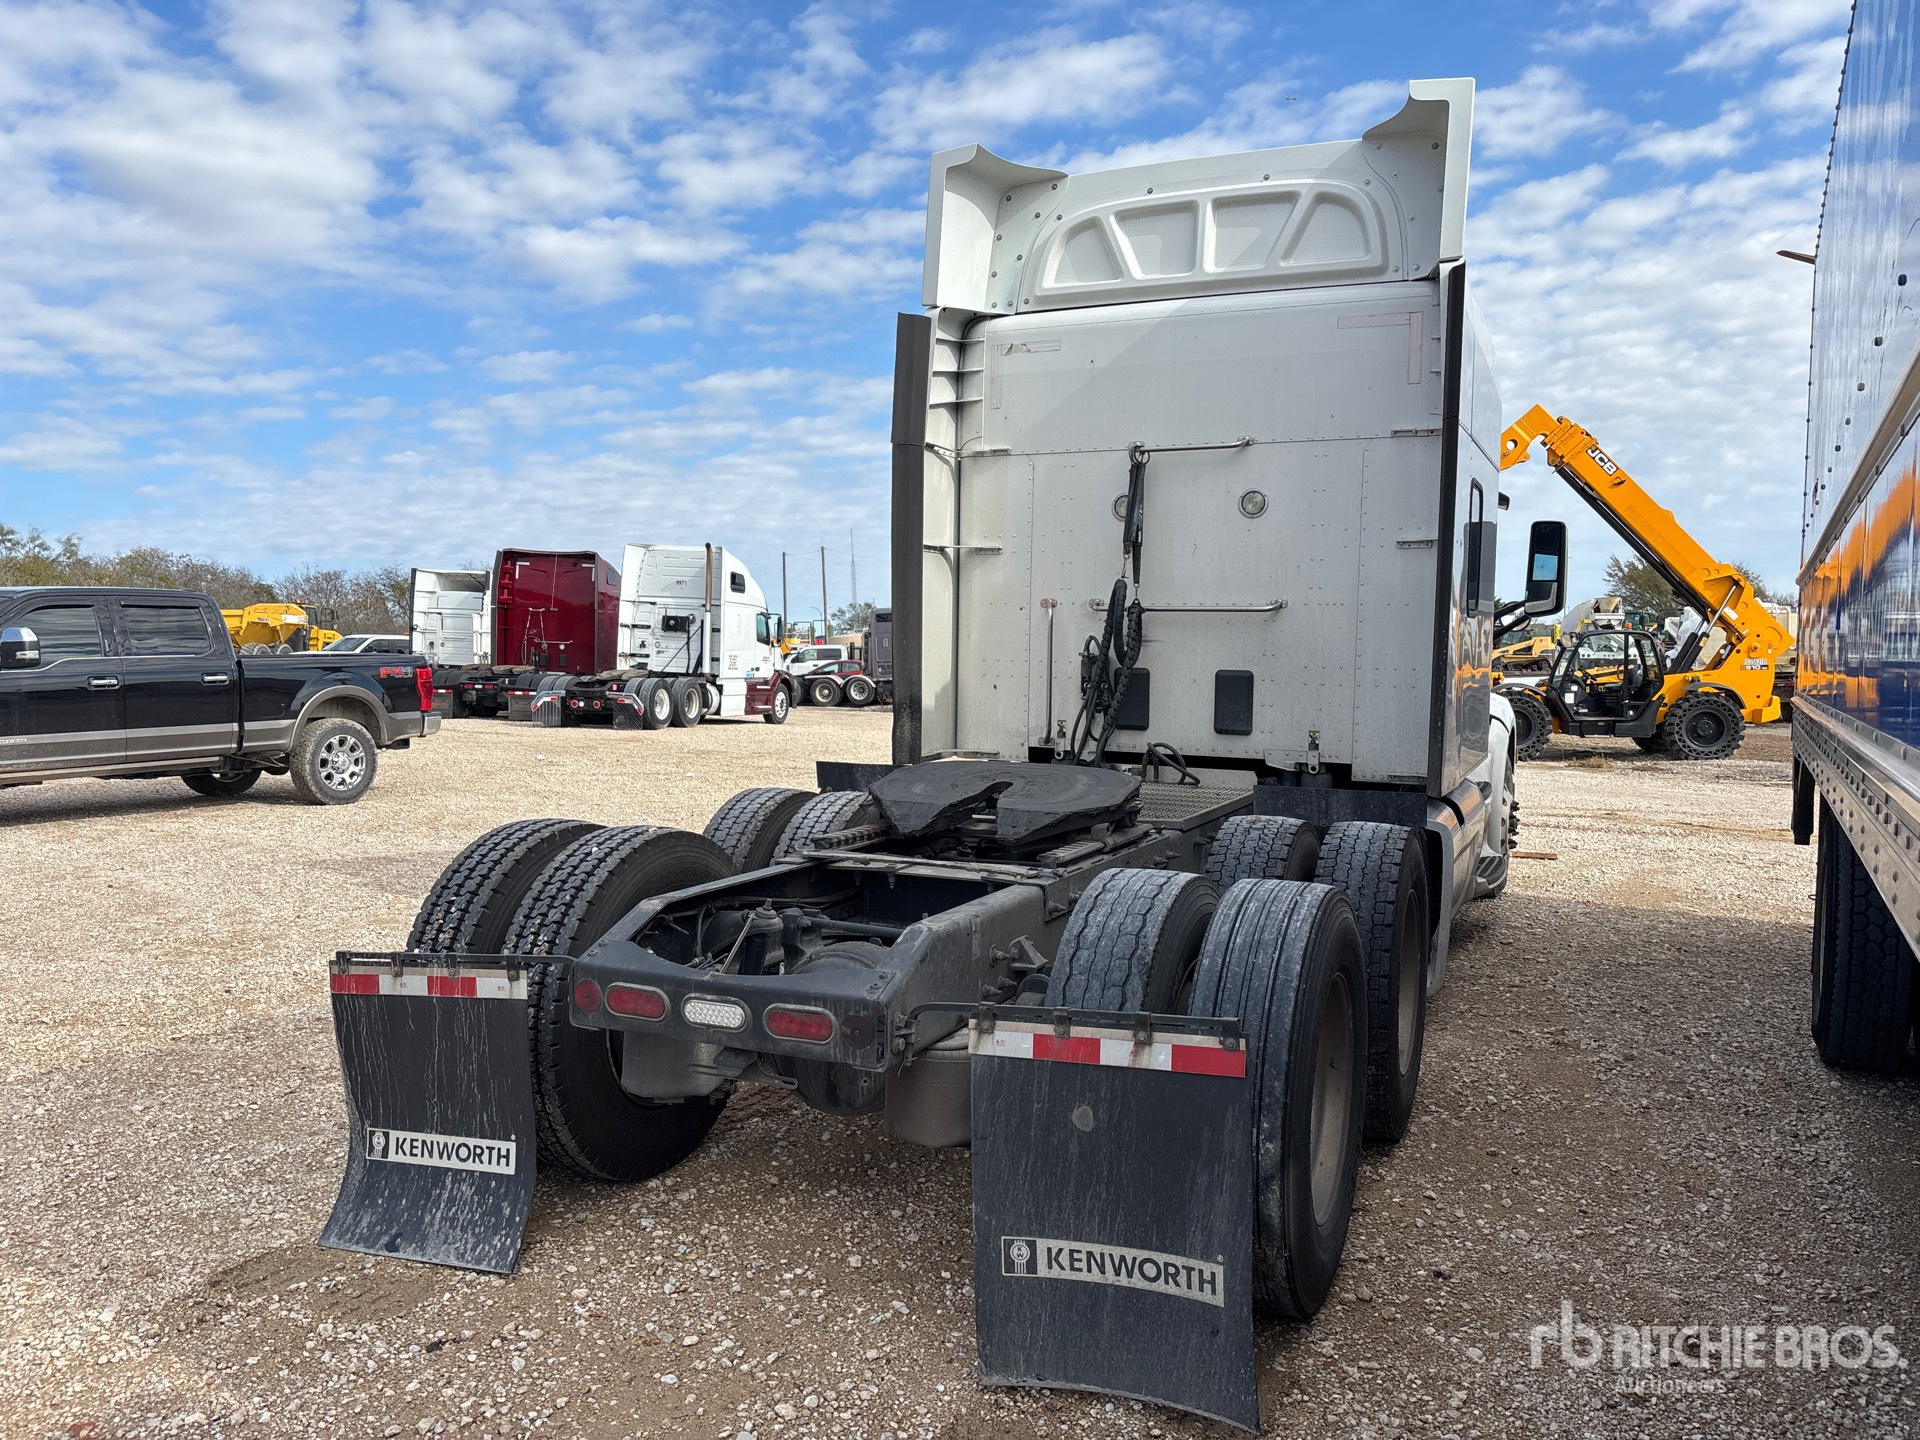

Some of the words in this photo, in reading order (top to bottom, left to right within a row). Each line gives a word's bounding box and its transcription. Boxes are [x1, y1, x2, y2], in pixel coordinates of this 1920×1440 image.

[1587, 448, 1618, 475] JCB
[379, 666, 414, 679] FX4
[395, 1136, 511, 1168] KENWORTH
[1046, 1246, 1217, 1296] KENWORTH
